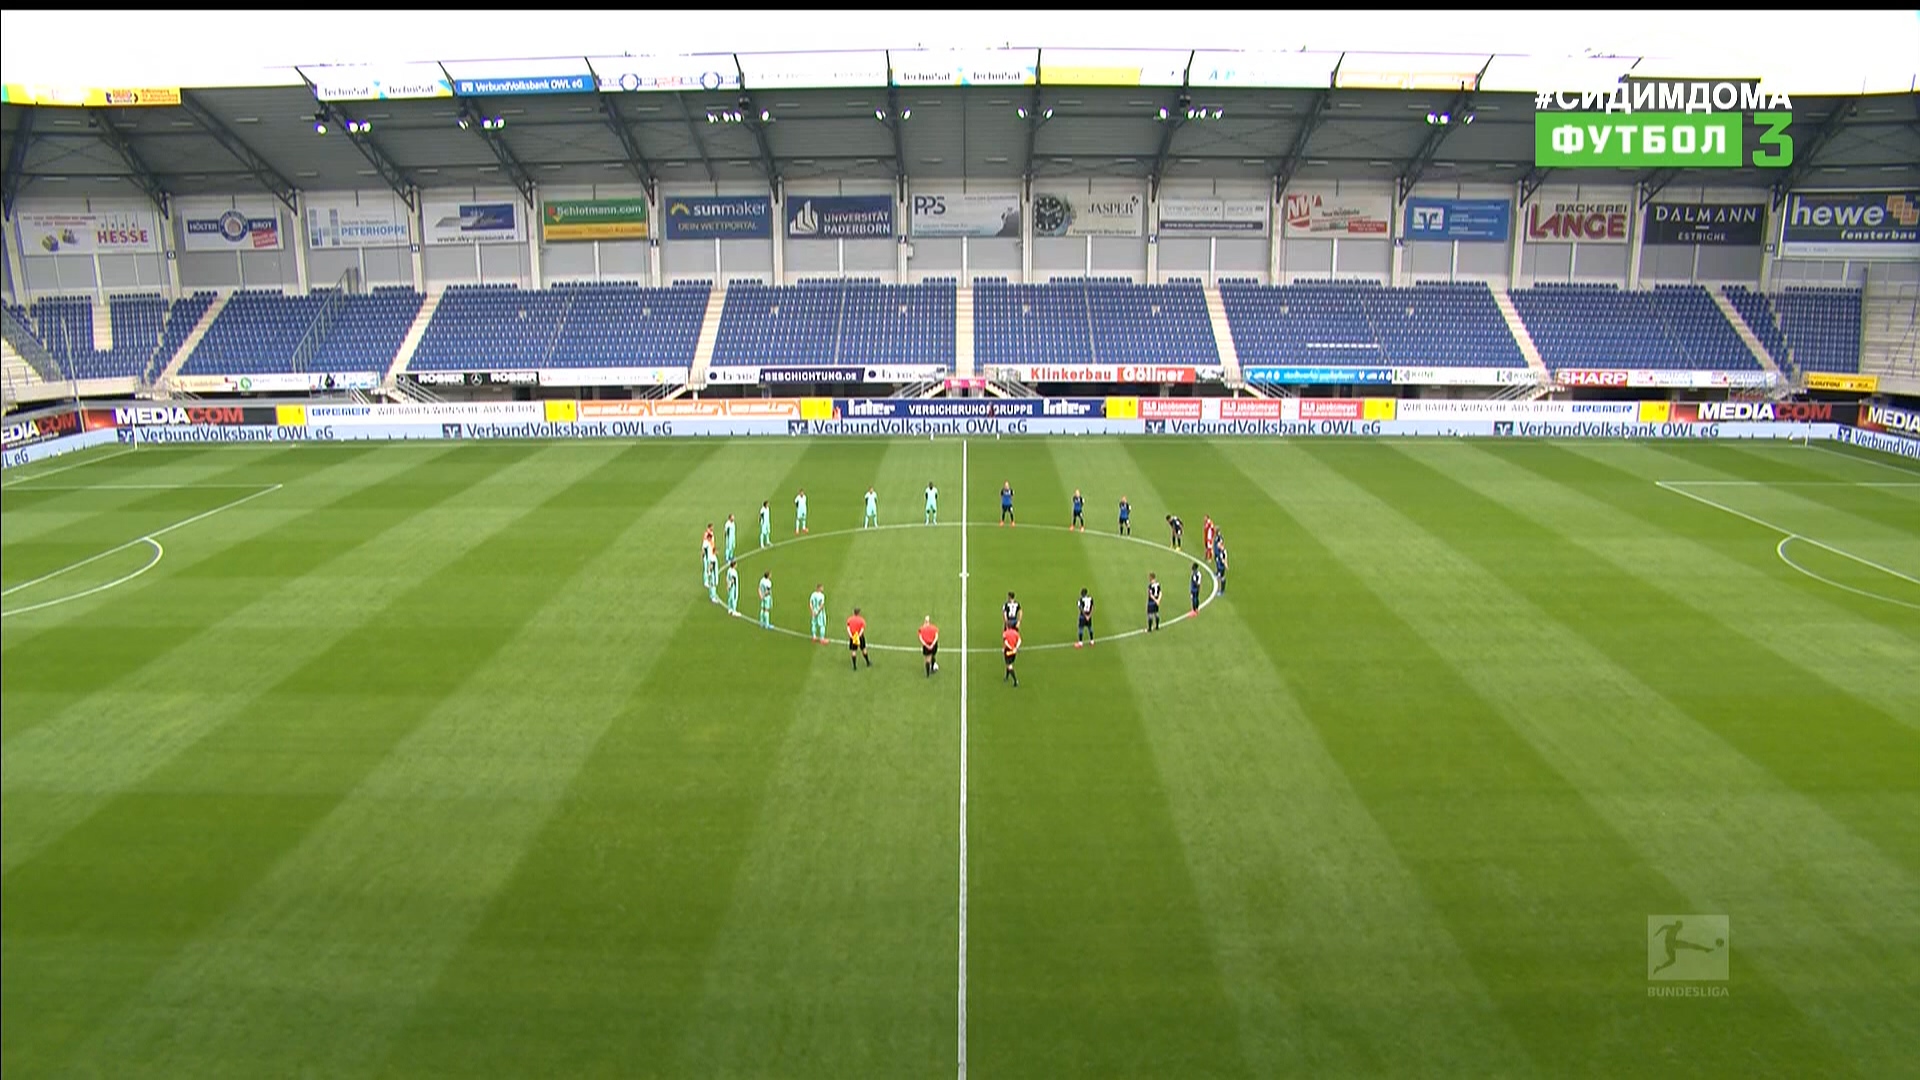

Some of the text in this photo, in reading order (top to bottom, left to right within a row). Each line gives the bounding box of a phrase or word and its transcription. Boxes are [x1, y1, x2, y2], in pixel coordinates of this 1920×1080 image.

[475, 79, 550, 92] VerbundVolksbank
[551, 80, 570, 89] OWL
[694, 201, 767, 216] sunmaker
[914, 195, 946, 216] PPS
[1088, 202, 1134, 214] JASPER
[1791, 195, 1884, 226] hewe
[1529, 203, 1626, 239] LANGE
[1655, 206, 1757, 222] DALMANN
[341, 225, 406, 236] PETERHOPPE
[678, 222, 699, 232] DEIN
[823, 223, 890, 235] PADERBORN
[1841, 229, 1917, 240] fensterbau
[97, 230, 148, 243] HESSE
[1677, 232, 1726, 241] ESTRICHE
[1031, 367, 1185, 382] Klinkerbau Göllner
[1557, 371, 1628, 385] SHARP
[115, 407, 244, 424] MEDIACOM
[1698, 402, 1833, 420] MEDIACOM
[140, 425, 334, 442] VerbundVolksbank OWL eG
[466, 420, 673, 437] VerbundVolksbank OWL eG
[814, 418, 1028, 434] VerbundVolksbank OWL eG
[1171, 419, 1381, 435] VerbundVolksbank OWL eG
[1519, 421, 1719, 437] VerbundVolksbank OWL eG
[14, 447, 30, 467] eG
